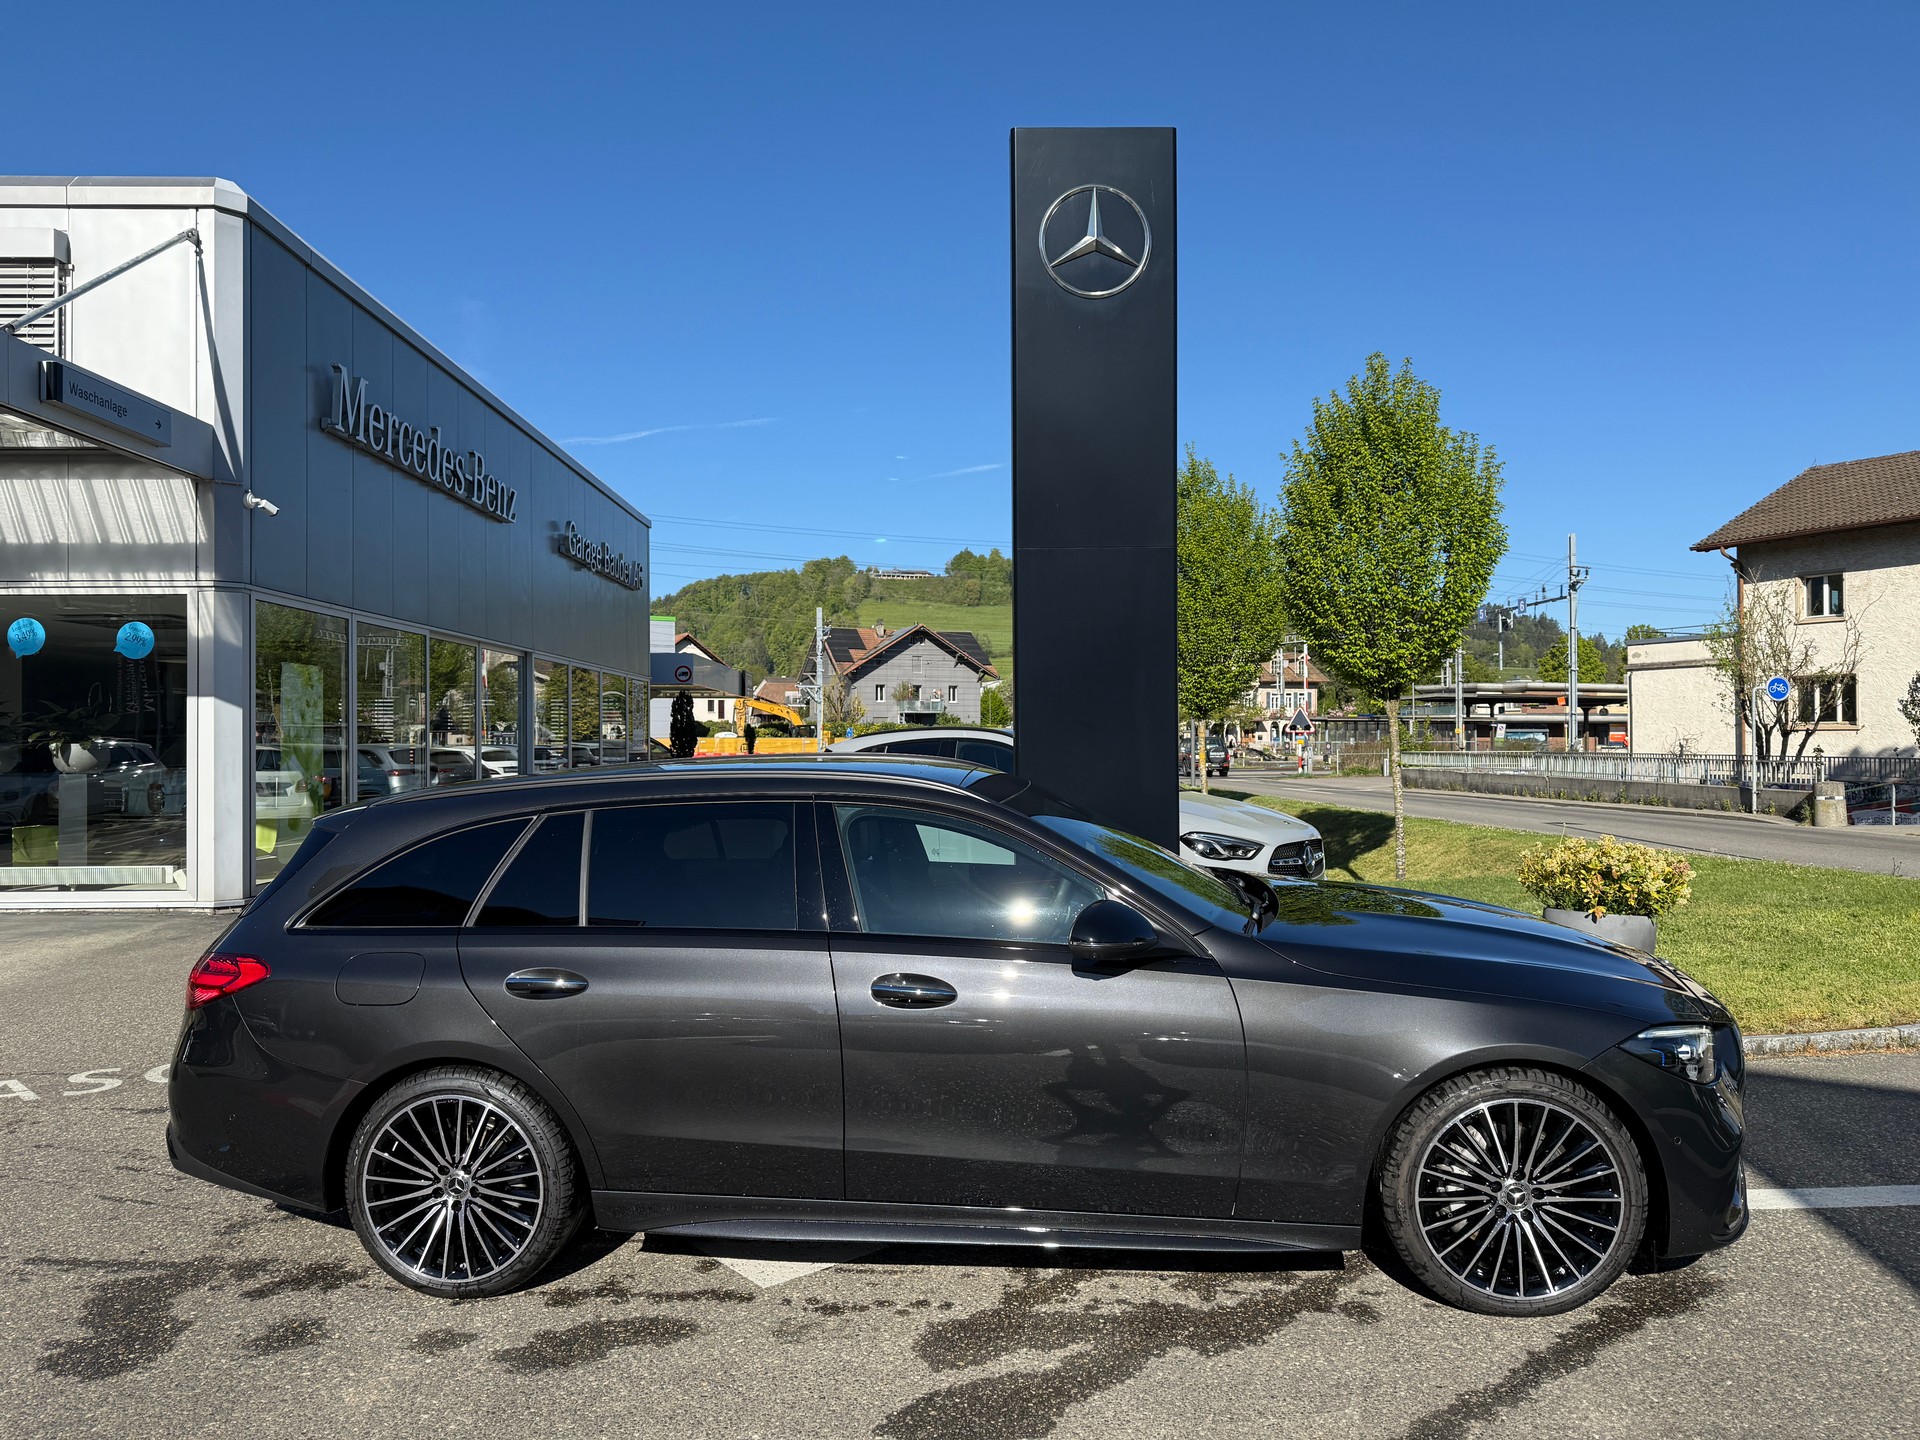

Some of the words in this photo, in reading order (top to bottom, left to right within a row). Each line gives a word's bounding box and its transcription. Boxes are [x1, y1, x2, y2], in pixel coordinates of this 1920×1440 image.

[69, 380, 128, 418] Waschanlage
[331, 363, 518, 524] Mercedes-Benz
[567, 520, 602, 573] Garage
[604, 542, 632, 585] Bauder
[14, 627, 38, 644] 3.49%
